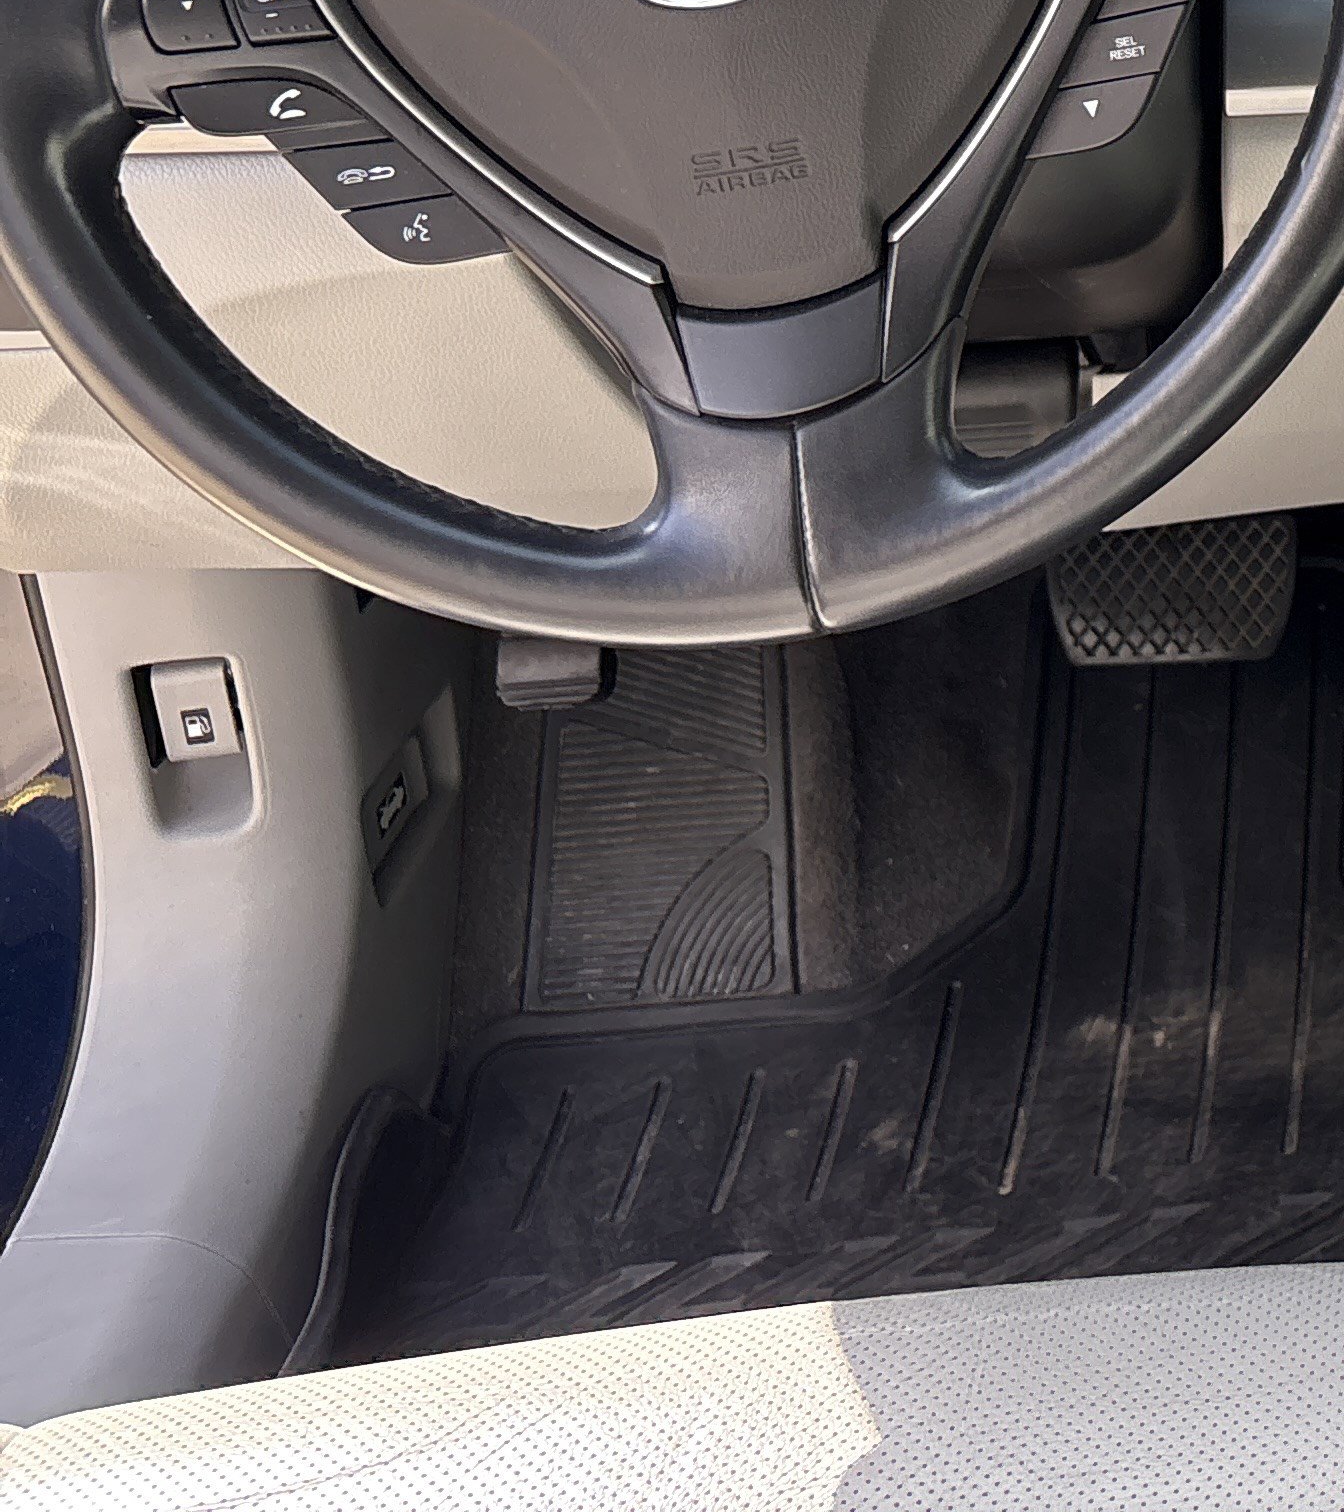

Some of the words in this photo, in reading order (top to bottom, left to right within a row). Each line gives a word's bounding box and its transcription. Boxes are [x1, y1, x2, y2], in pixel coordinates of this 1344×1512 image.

[1109, 45, 1145, 61] RESET
[1115, 36, 1138, 48] SEL
[692, 138, 800, 173] SRS
[697, 165, 808, 196] AIRBAG
